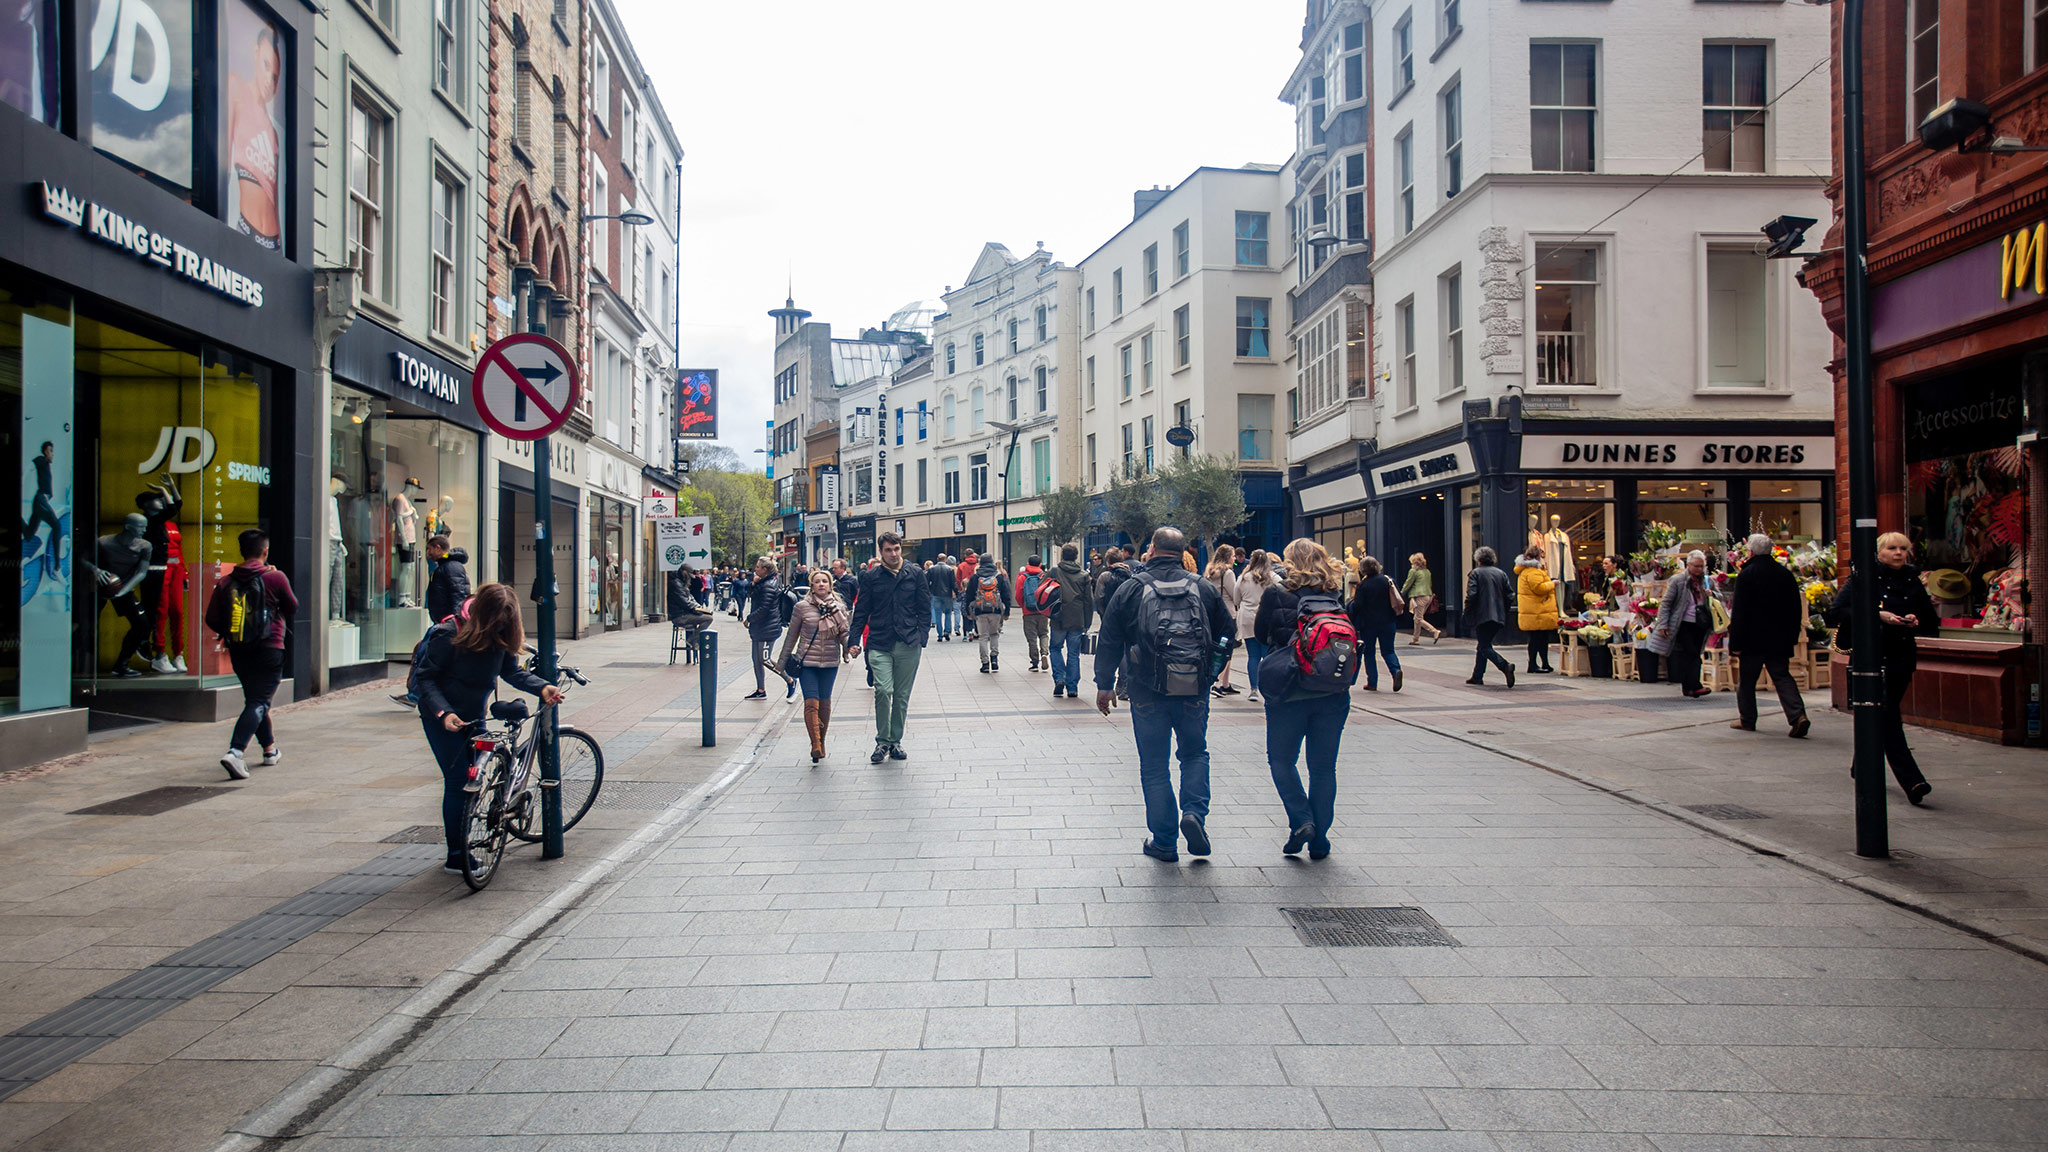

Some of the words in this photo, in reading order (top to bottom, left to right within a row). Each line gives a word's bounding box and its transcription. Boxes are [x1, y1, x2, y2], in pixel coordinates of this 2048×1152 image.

[91, 202, 149, 255] KING
[151, 233, 172, 258] OF
[173, 243, 263, 307] TRAINERS
[398, 351, 459, 405] TOPMAN
[878, 393, 887, 446] CAMERA
[1912, 390, 2016, 438] Accessorize
[138, 426, 216, 474] JD
[228, 461, 270, 485] SPRING
[550, 438, 576, 475] AKER
[1562, 443, 1676, 463] DUNNES
[1702, 444, 1804, 463] STORES
[878, 450, 887, 503] CENTRE
